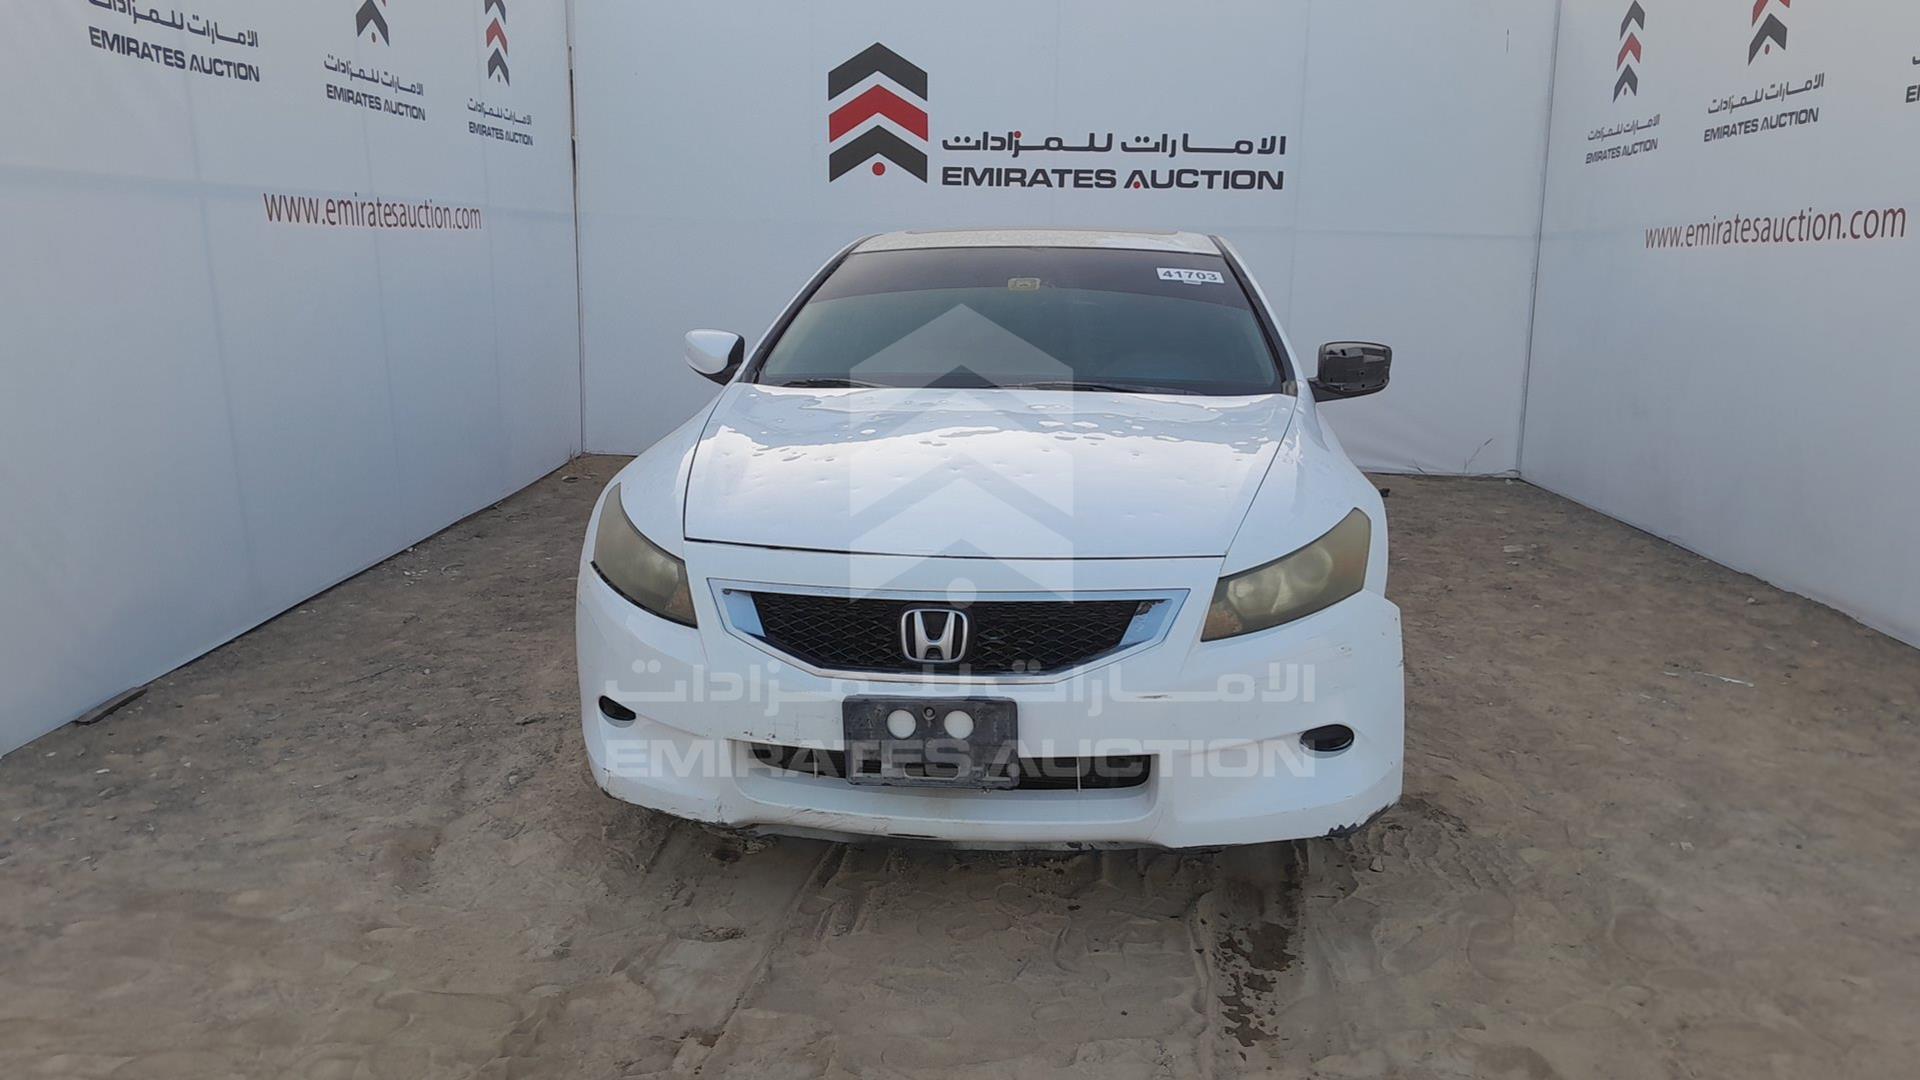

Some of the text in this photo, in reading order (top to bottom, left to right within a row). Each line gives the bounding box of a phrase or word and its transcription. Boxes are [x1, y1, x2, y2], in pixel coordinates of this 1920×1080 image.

[88, 26, 260, 82] EMIRATES AUCTION
[326, 83, 426, 121] EMIRATES AUCTION
[468, 121, 533, 146] EMIRATES AUCTION
[1703, 107, 1820, 142] EMIRATES AUCTION
[942, 130, 1287, 158] الامارات للمزادات
[1585, 138, 1659, 164] EMIRATES AUCTION
[942, 166, 1285, 190] EMIRATES AUCTION
[263, 192, 482, 230] www.emiratesauction.com
[1645, 207, 1906, 249] www.emiratesauction.com
[1161, 269, 1218, 281] 41703
